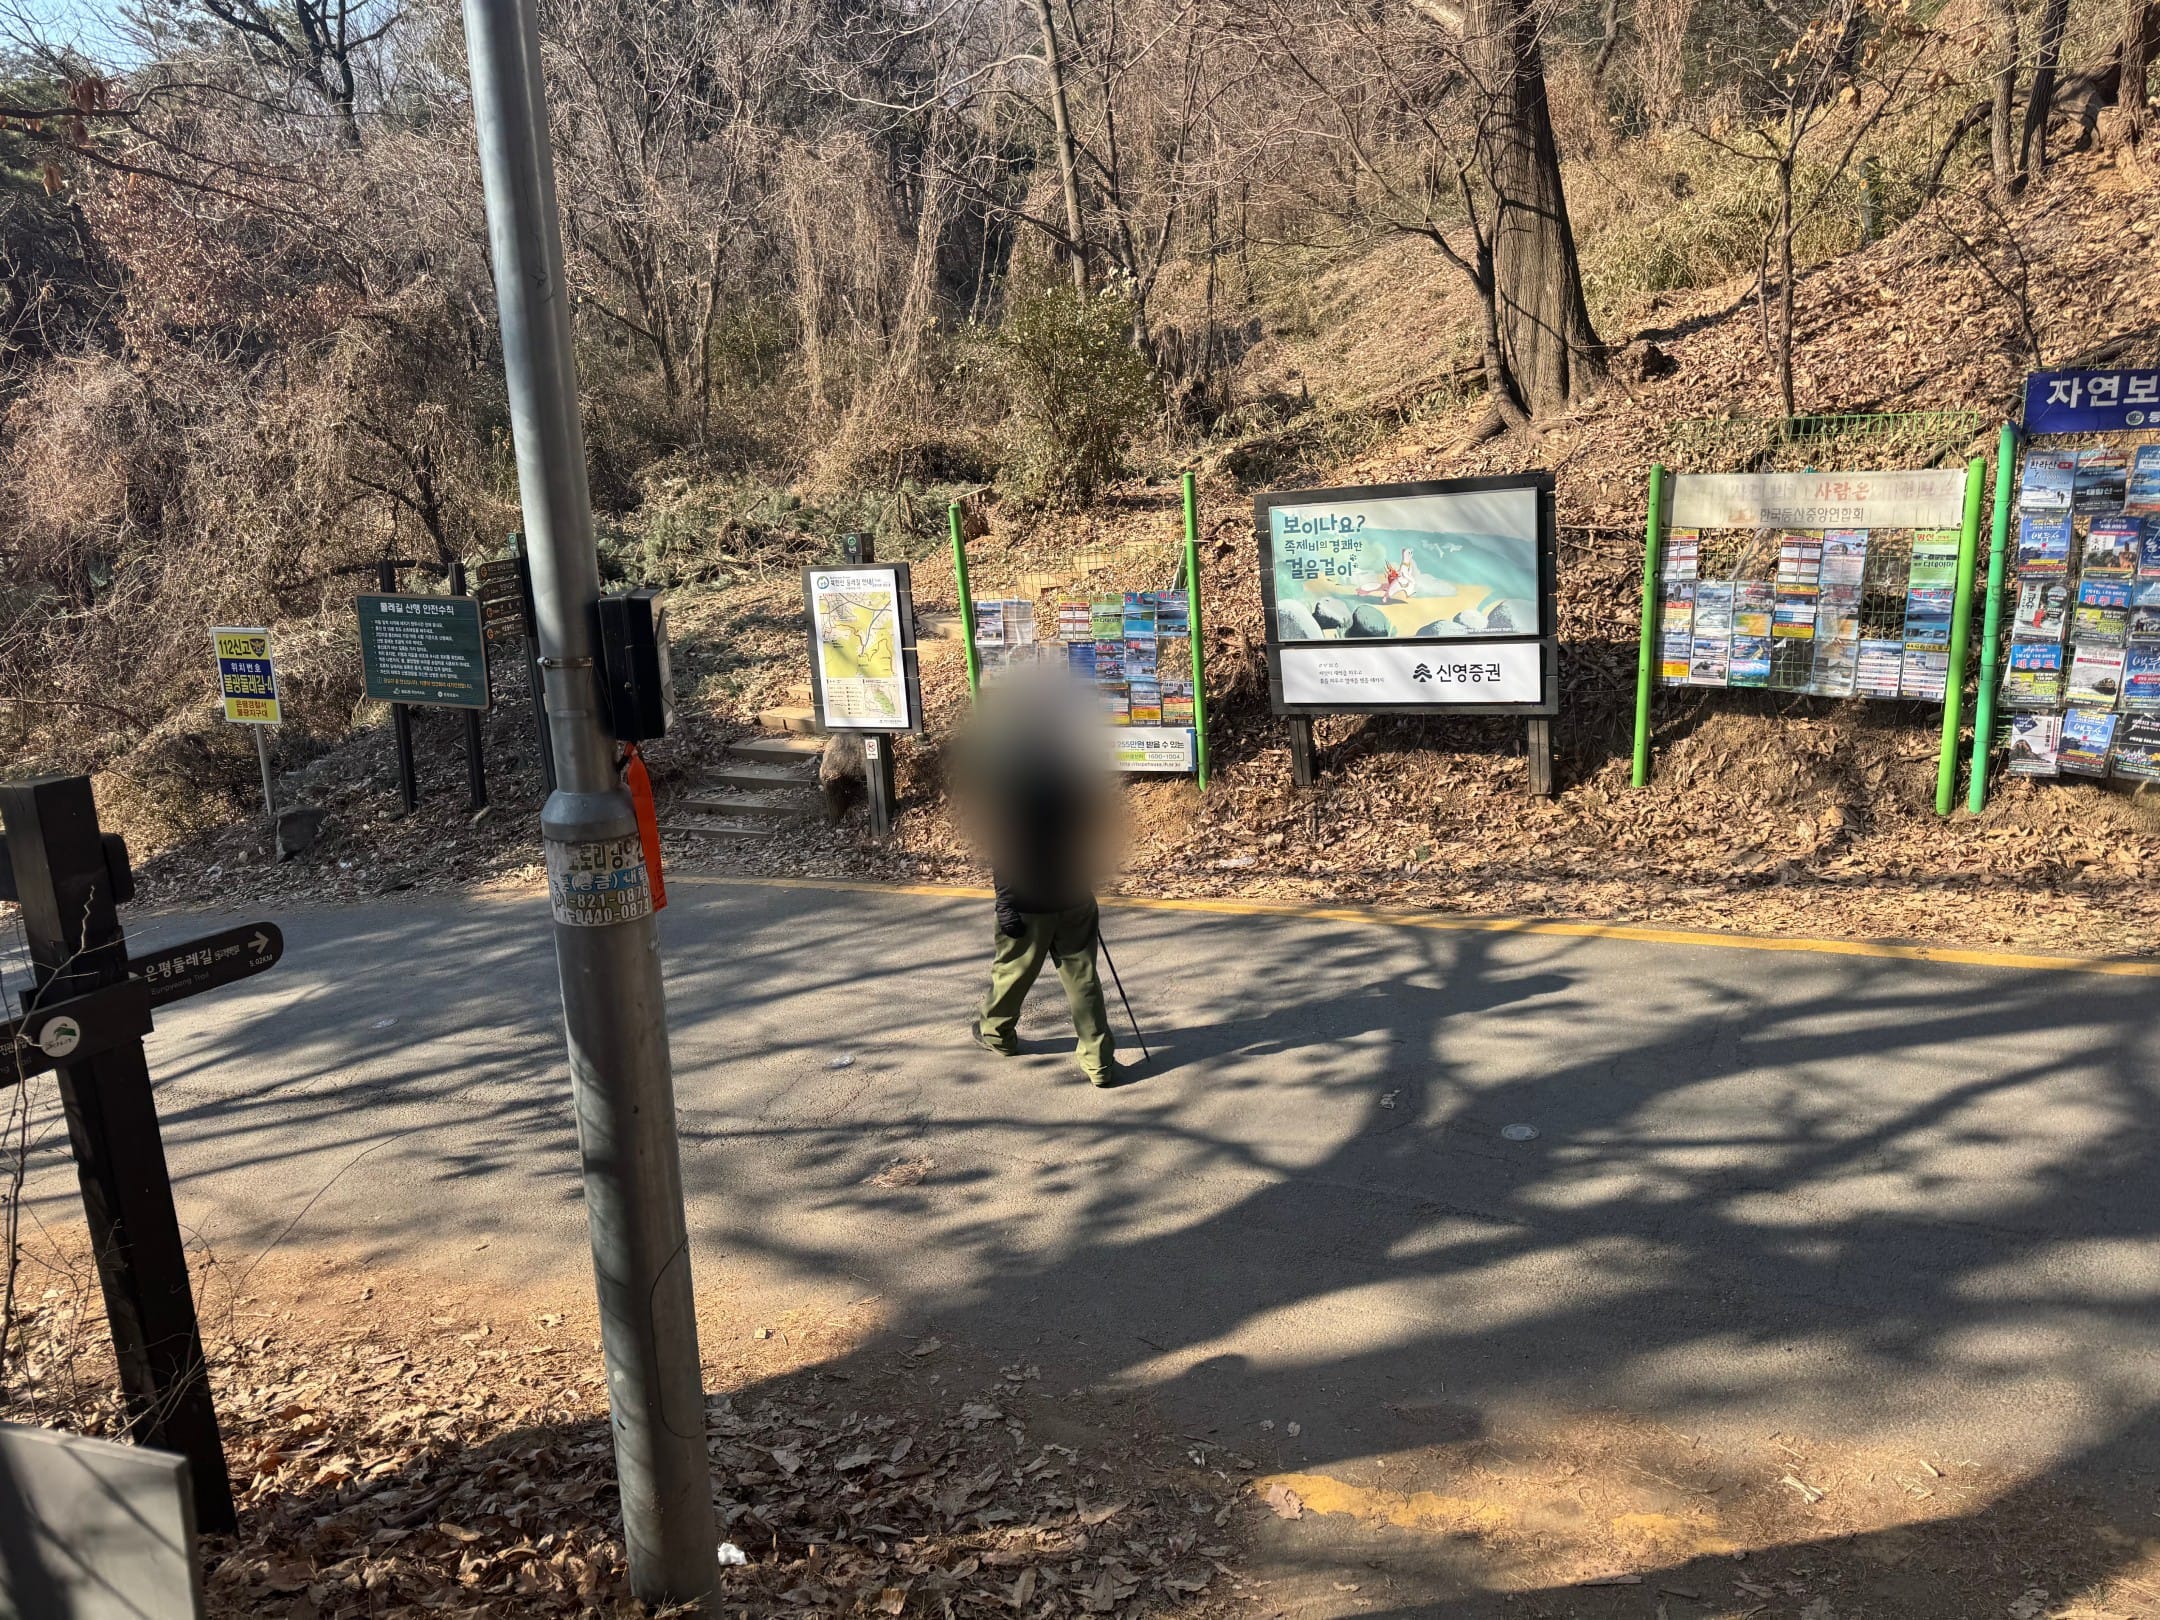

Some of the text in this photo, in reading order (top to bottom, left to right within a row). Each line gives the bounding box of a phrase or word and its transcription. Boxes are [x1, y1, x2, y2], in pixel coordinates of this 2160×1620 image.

[1814, 482, 1870, 502] 사람은
[1759, 507, 1864, 524] 한국등산중앙연합회
[1283, 514, 1366, 535] 보이나요?
[1284, 538, 1362, 553] 족제비의 경쾌한
[1286, 556, 1353, 580] 걸음걸이
[380, 602, 455, 616] 둘레길 산행 안전수칙
[218, 639, 252, 657] 112신고
[230, 662, 262, 673] 위치번호
[1436, 662, 1501, 683] 신영증권
[235, 700, 267, 709] 은평경찰서
[236, 708, 268, 718] 불광지구대
[1162, 741, 1169, 749] 수
[1170, 741, 1185, 749] 있는
[145, 947, 213, 983] 은평둘레길
